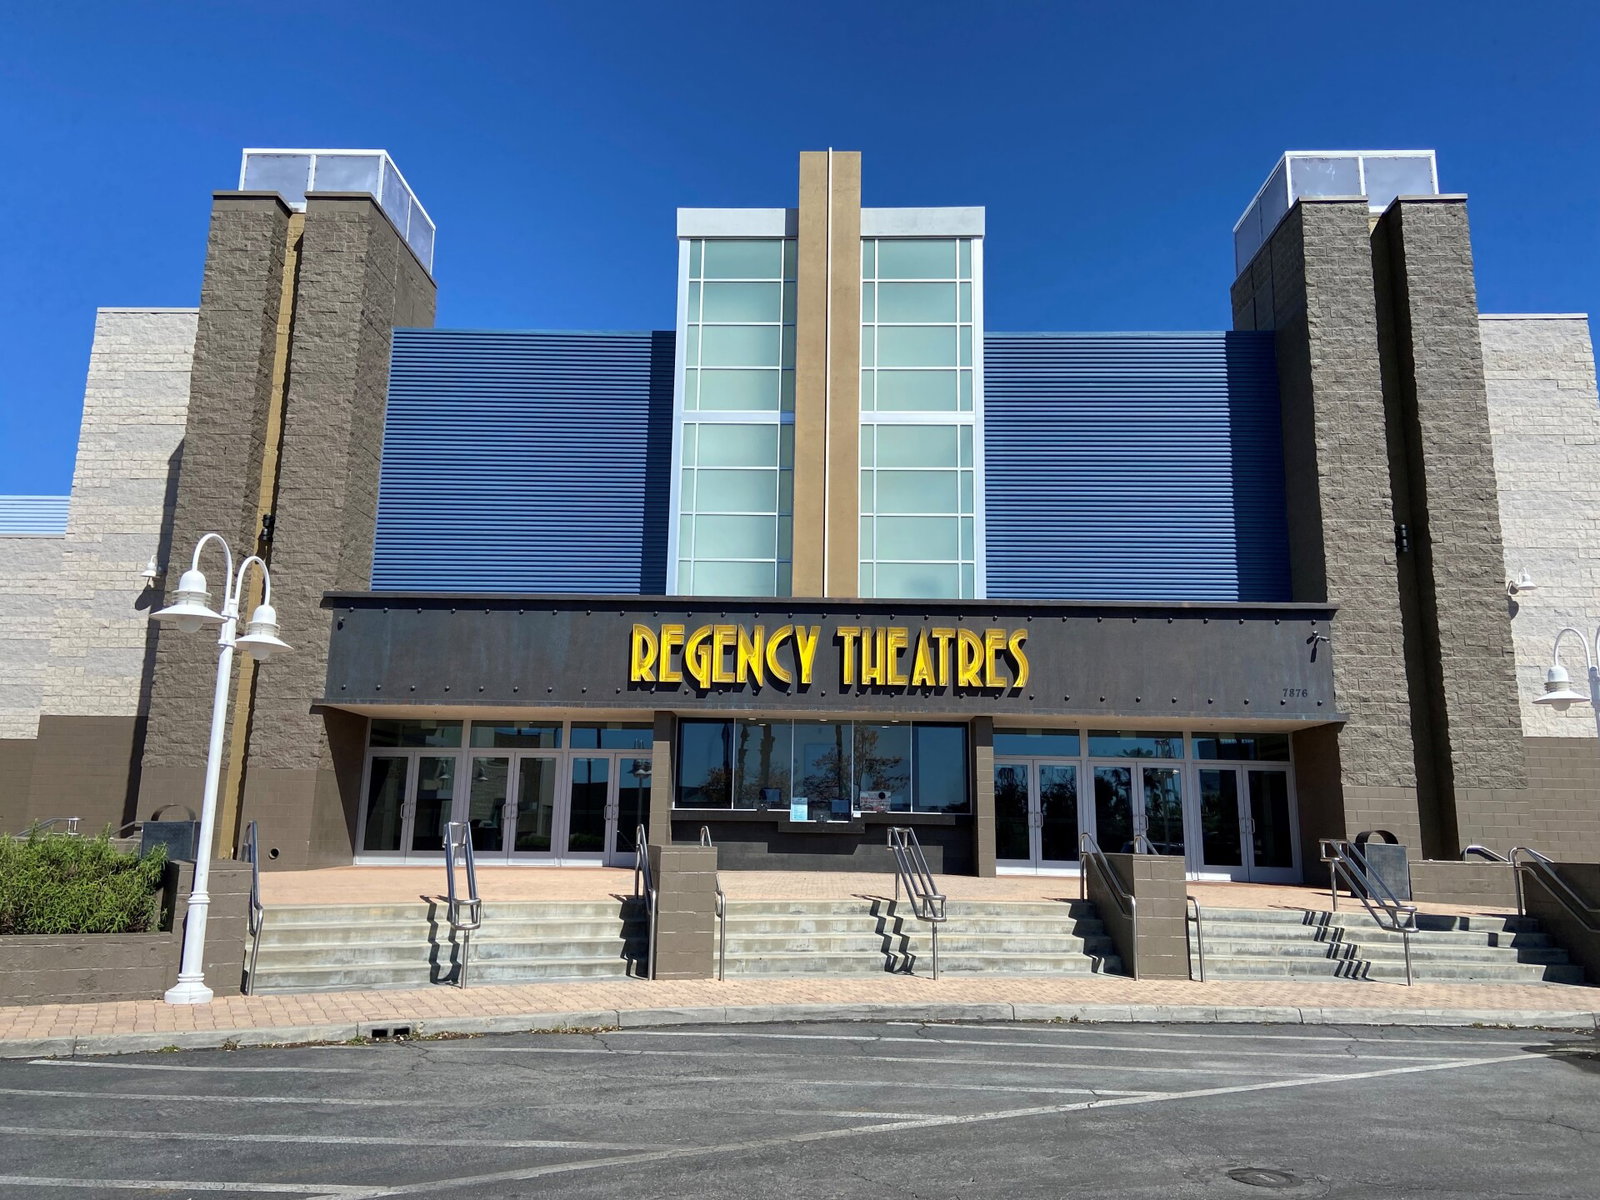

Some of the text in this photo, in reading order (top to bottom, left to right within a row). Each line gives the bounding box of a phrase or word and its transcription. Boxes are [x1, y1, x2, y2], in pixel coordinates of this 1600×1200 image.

[629, 623, 1029, 690] REGENCY THEATRES
[1282, 688, 1308, 698] 7876
